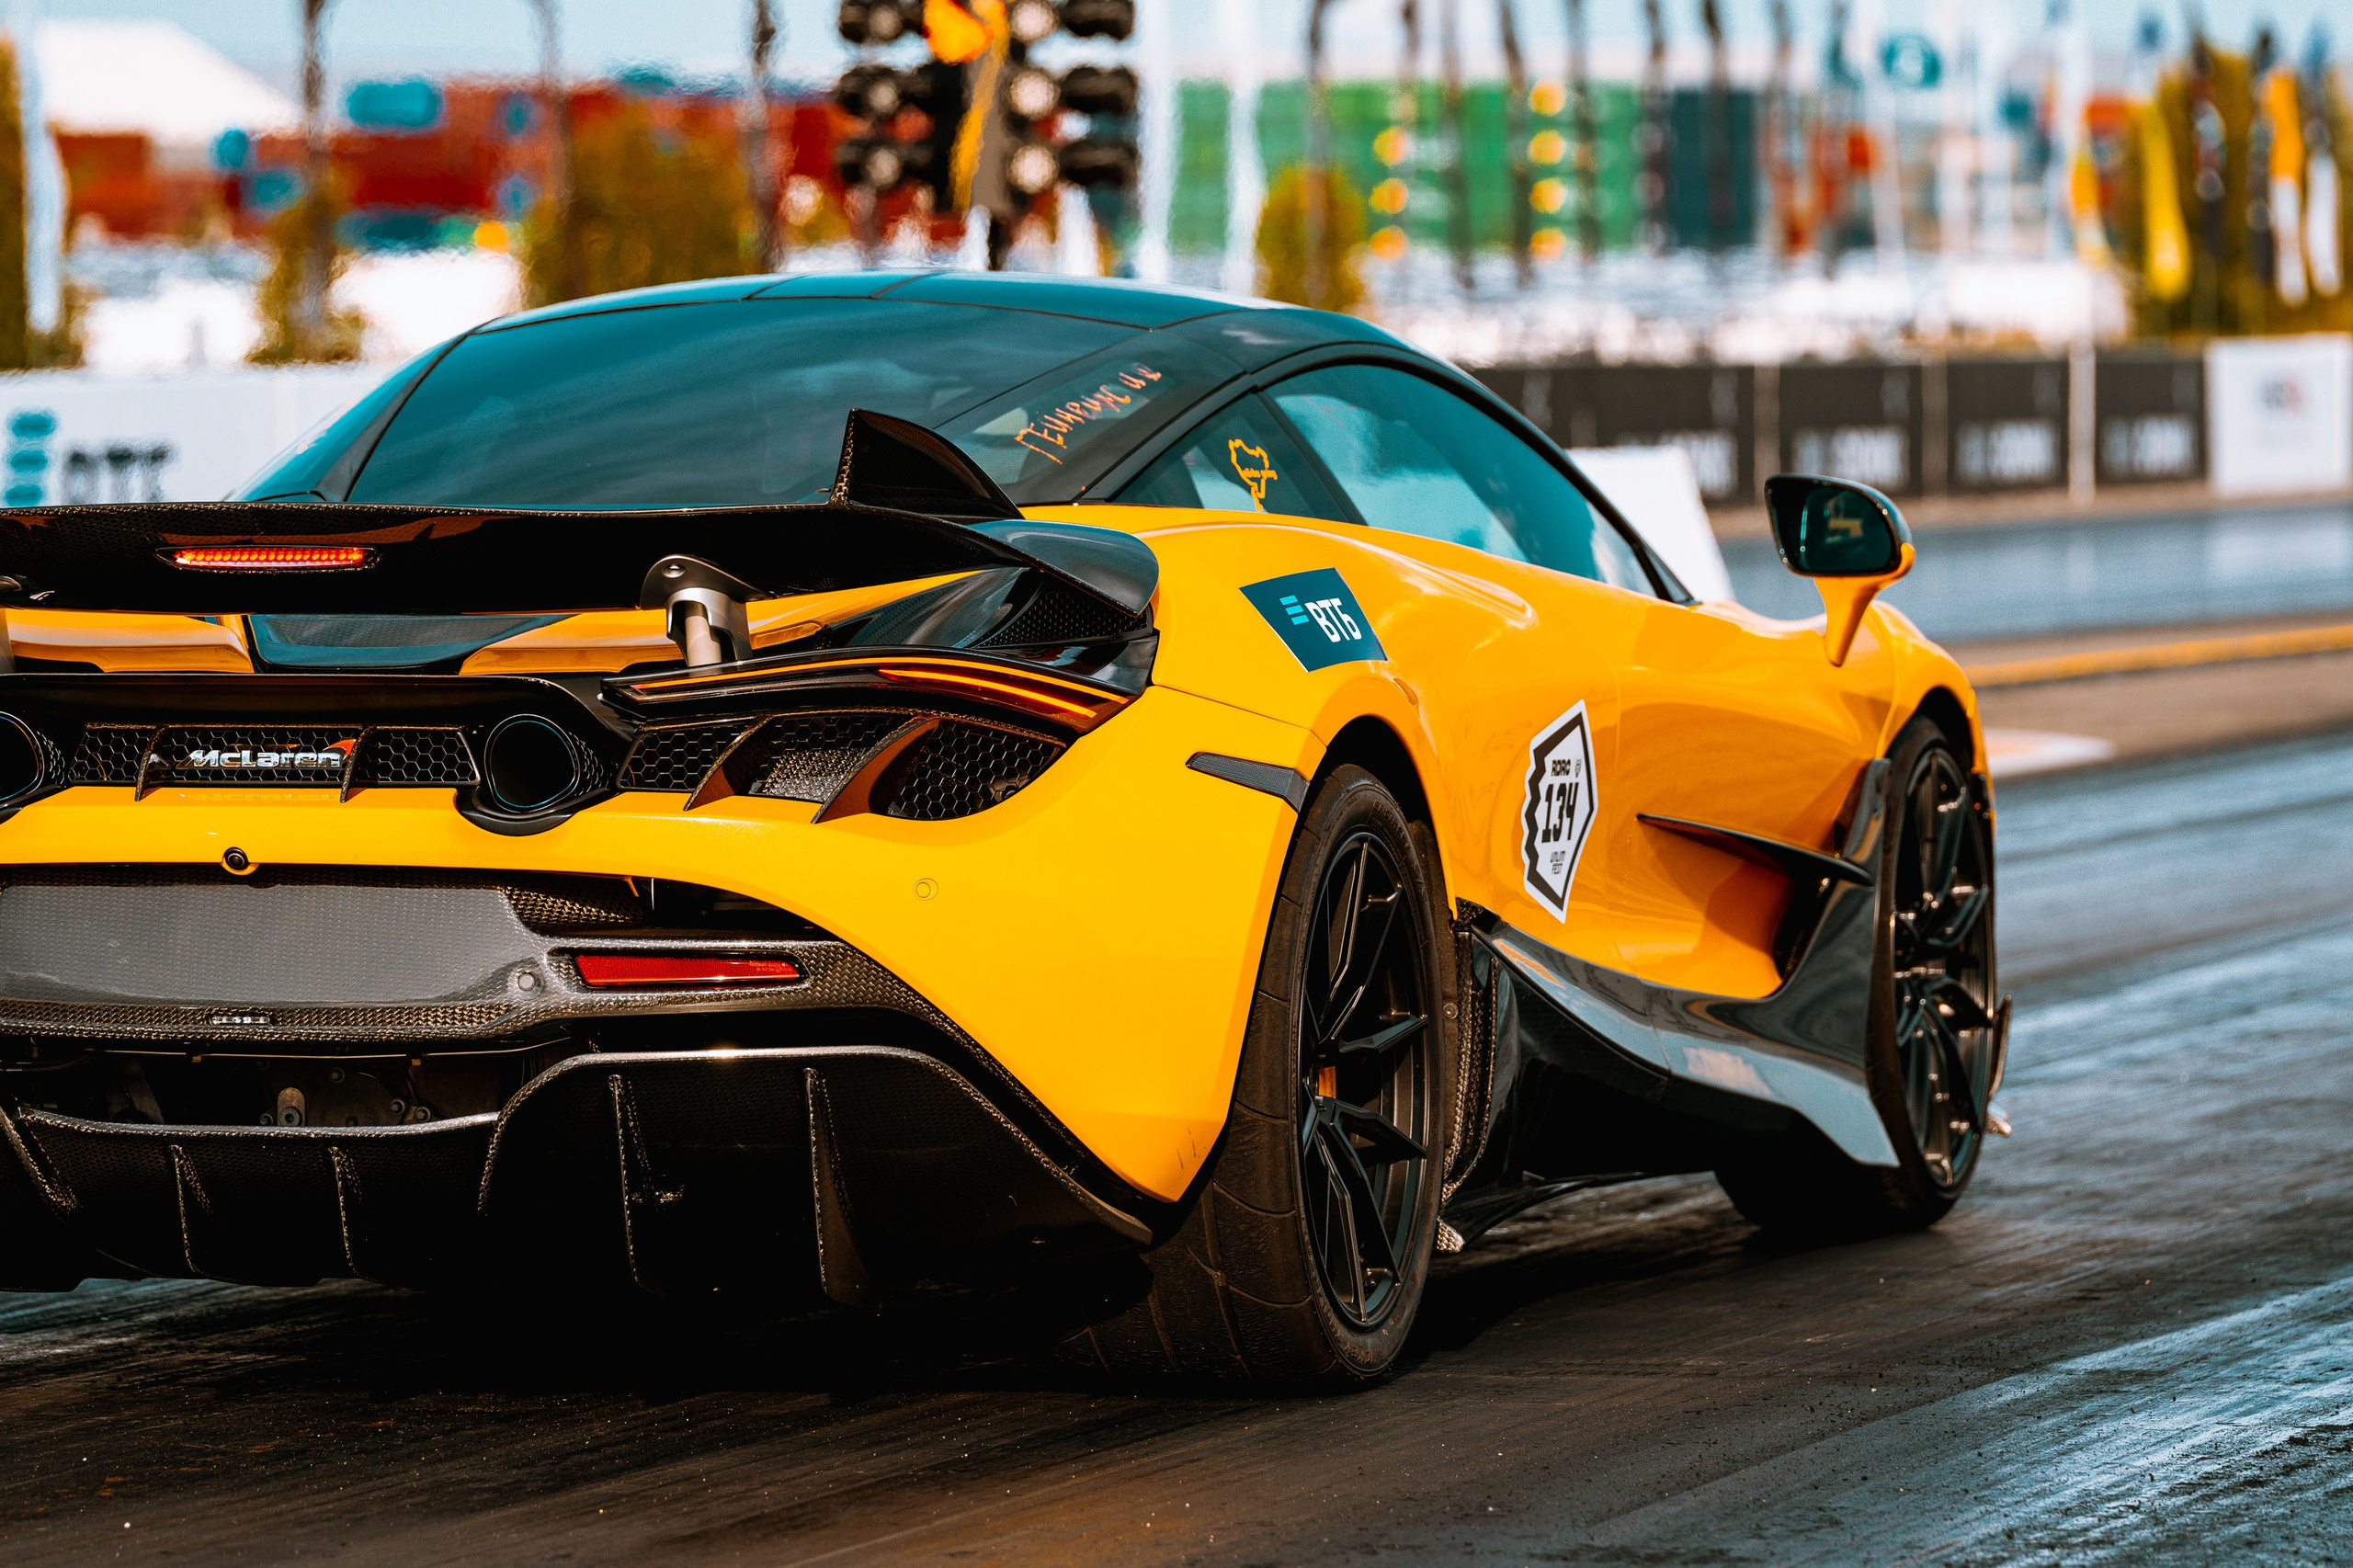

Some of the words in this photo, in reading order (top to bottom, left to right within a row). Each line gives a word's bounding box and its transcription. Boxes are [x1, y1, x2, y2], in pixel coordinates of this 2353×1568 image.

[1304, 597, 1362, 643] ВТБ
[184, 749, 341, 768] McLaren
[1541, 781, 1579, 843] 134
